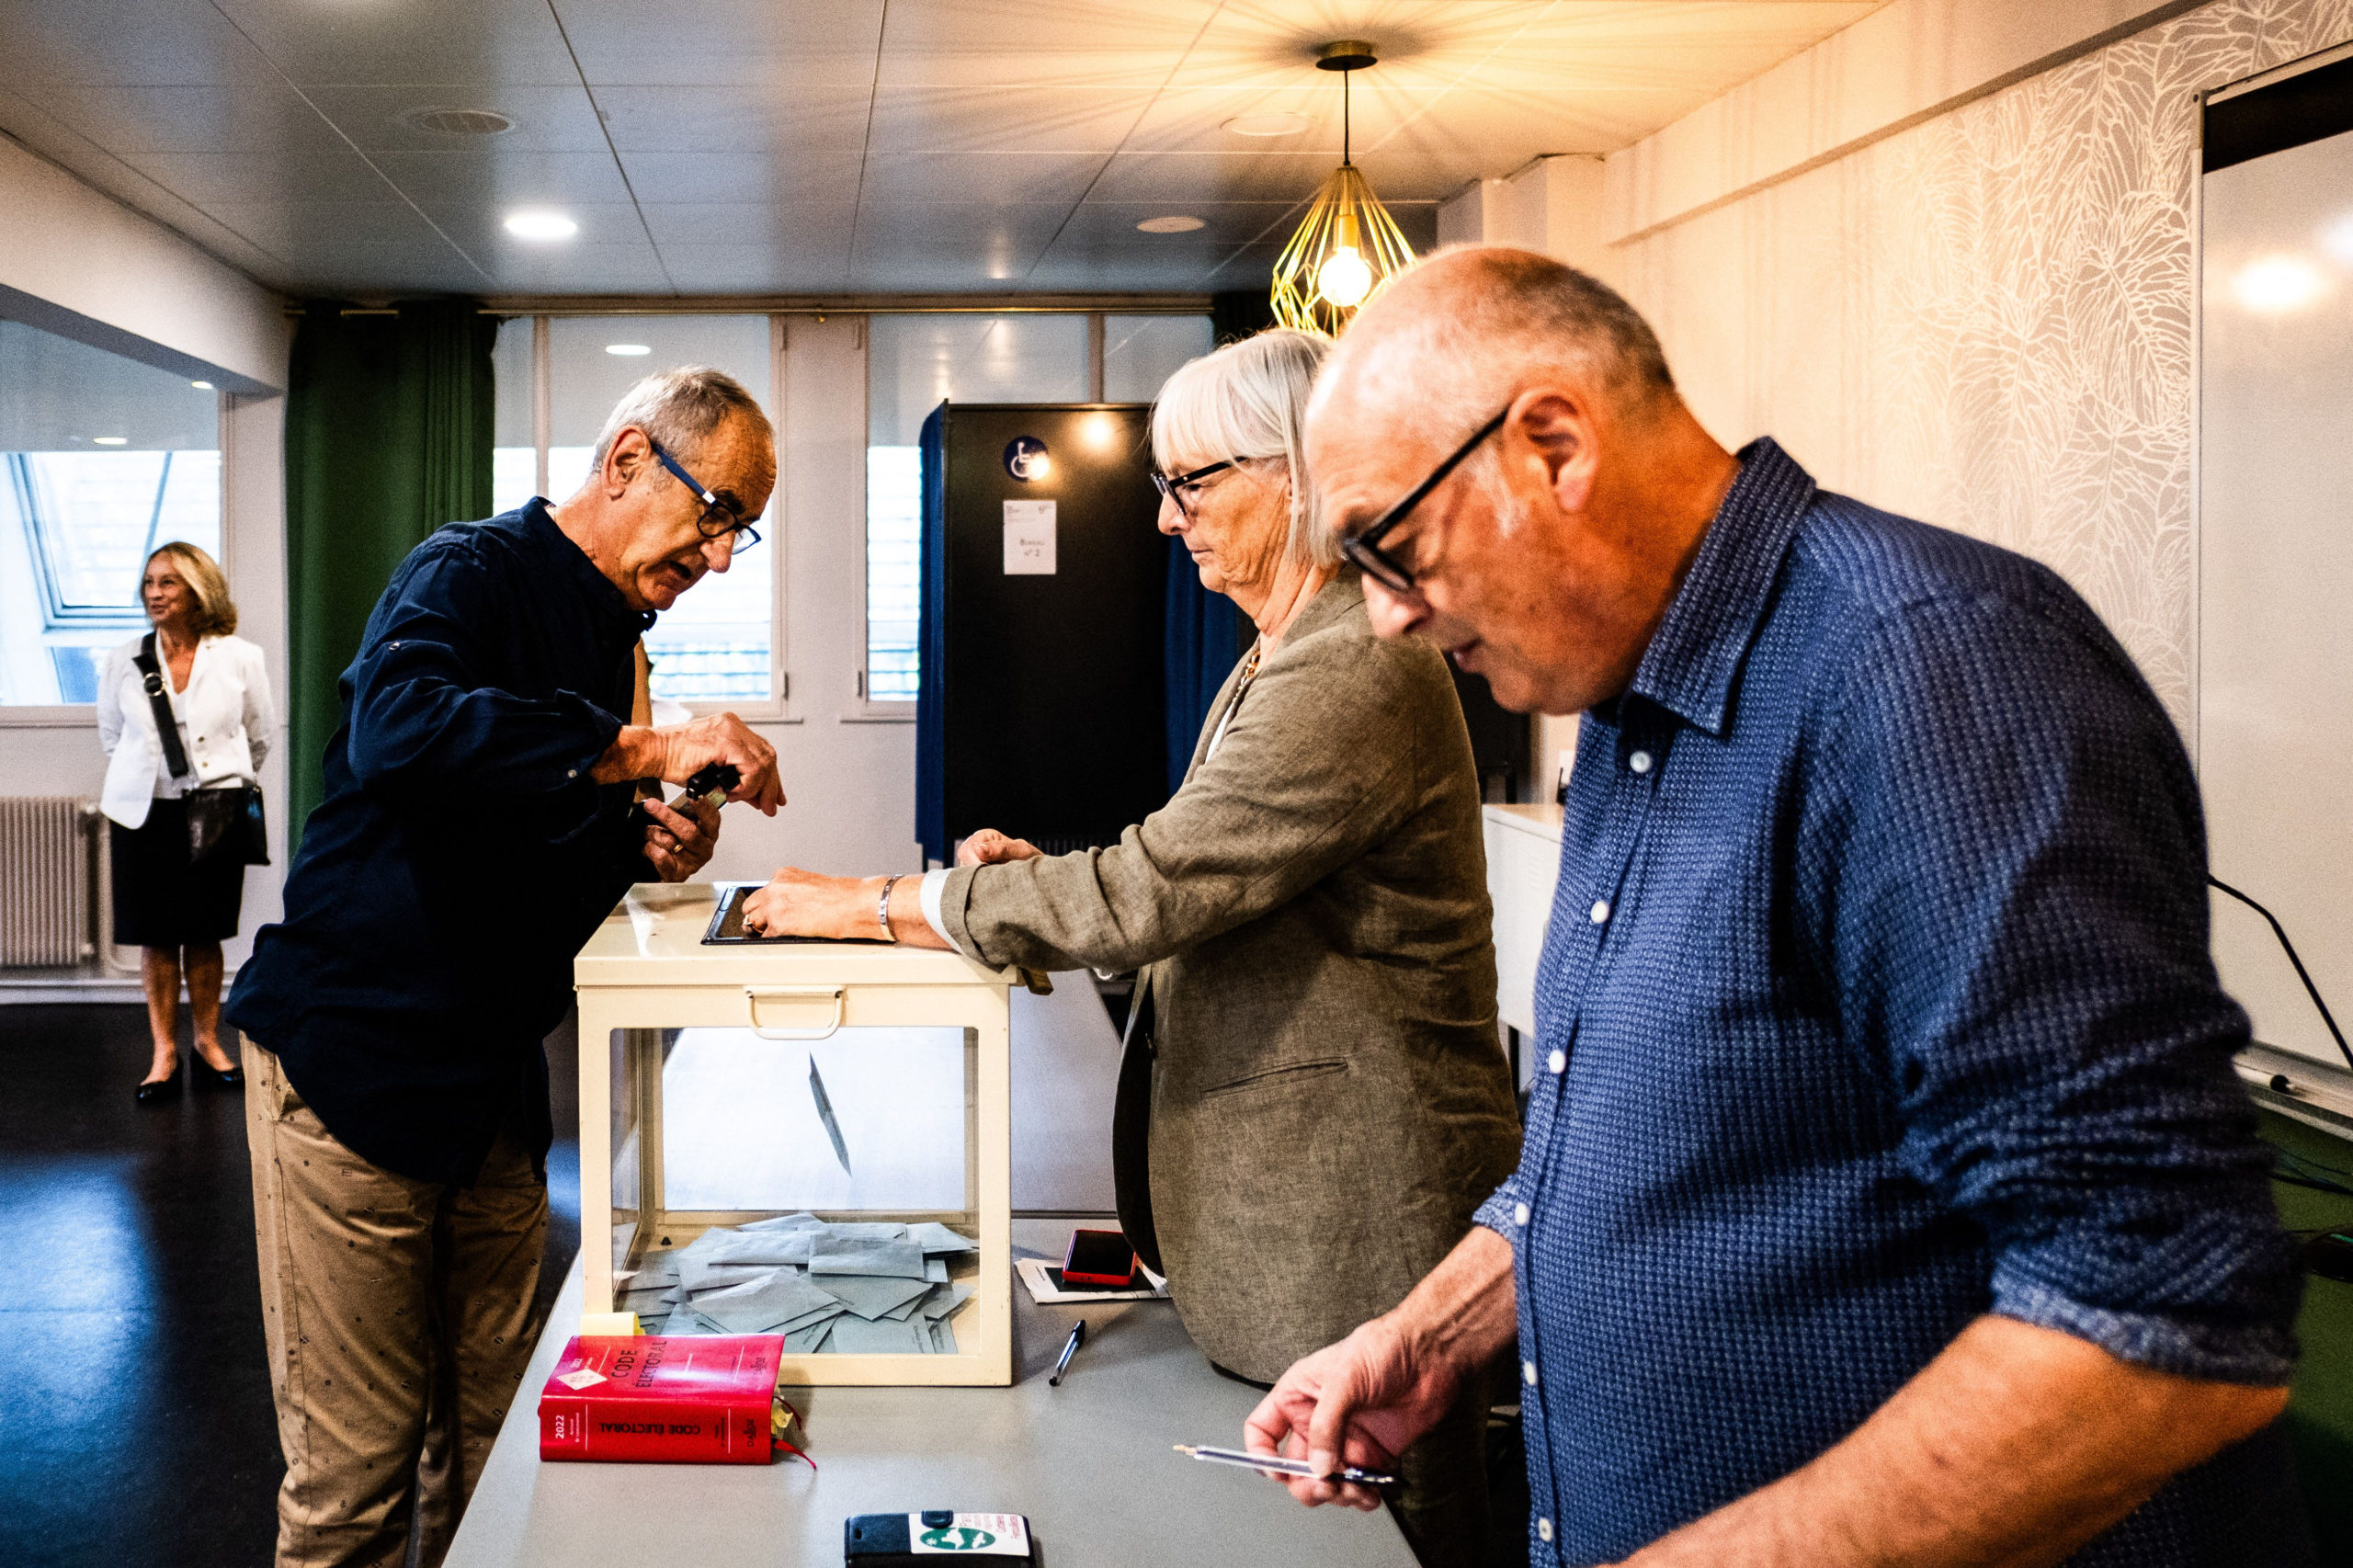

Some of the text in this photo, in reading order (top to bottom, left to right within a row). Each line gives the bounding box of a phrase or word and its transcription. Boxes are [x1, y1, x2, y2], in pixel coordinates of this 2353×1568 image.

[611, 1350, 638, 1378] CODE
[555, 1415, 564, 1439] 2022
[669, 1425, 700, 1436] CODE
